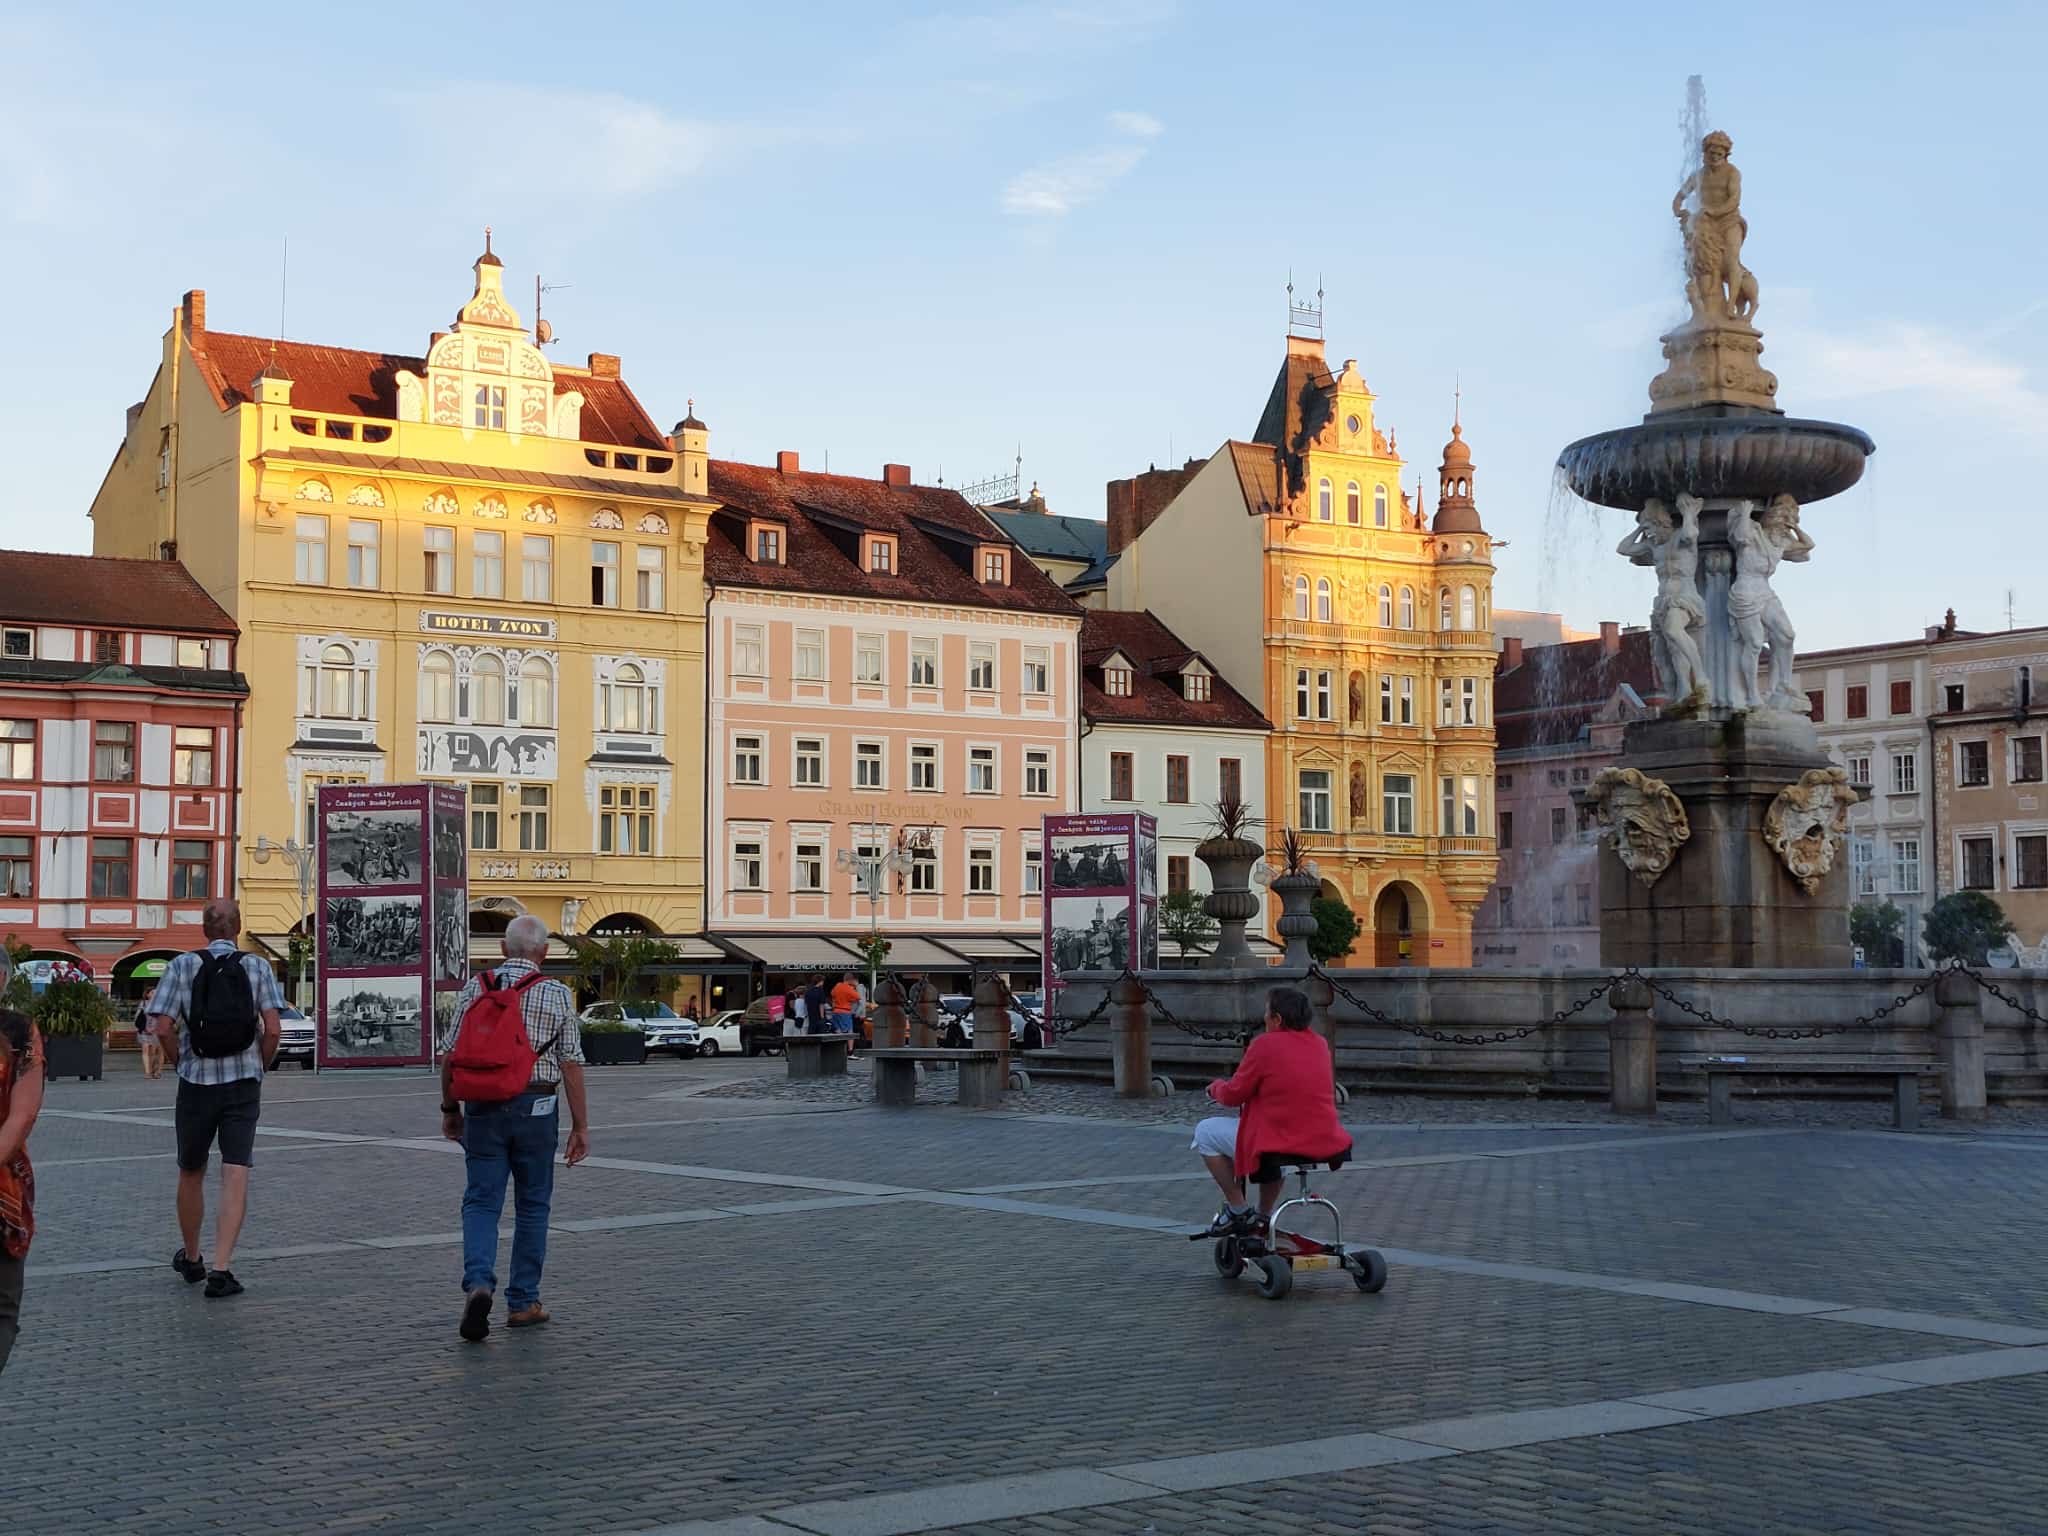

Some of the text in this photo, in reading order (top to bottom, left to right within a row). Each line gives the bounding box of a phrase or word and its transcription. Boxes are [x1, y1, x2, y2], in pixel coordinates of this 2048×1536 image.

[435, 616, 542, 634] HOTEL ZVON
[817, 800, 974, 820] GRAND HOTEL ZVON
